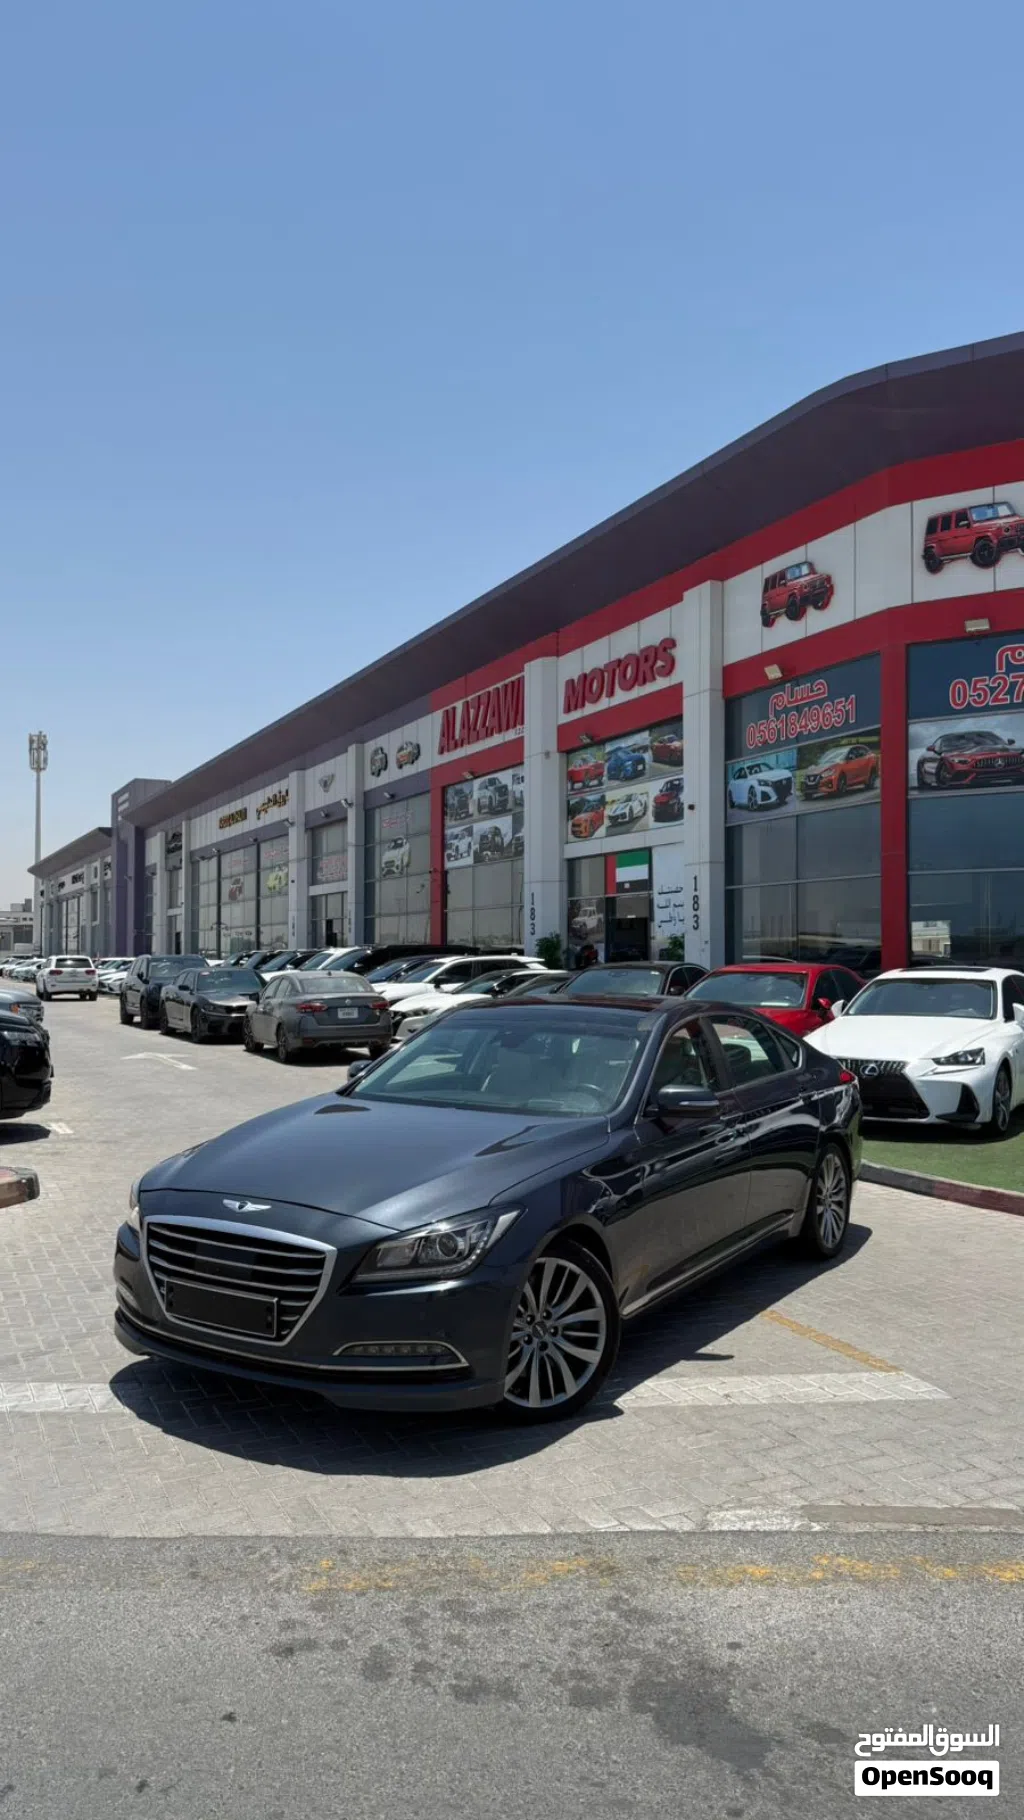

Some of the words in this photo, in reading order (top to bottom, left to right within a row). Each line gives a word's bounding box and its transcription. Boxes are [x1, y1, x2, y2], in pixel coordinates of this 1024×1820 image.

[438, 675, 524, 755] ALAZZAWI
[563, 637, 677, 714] MOTORS
[746, 694, 856, 749] 0561849651
[769, 679, 828, 719] حسام
[692, 874, 700, 931] 183
